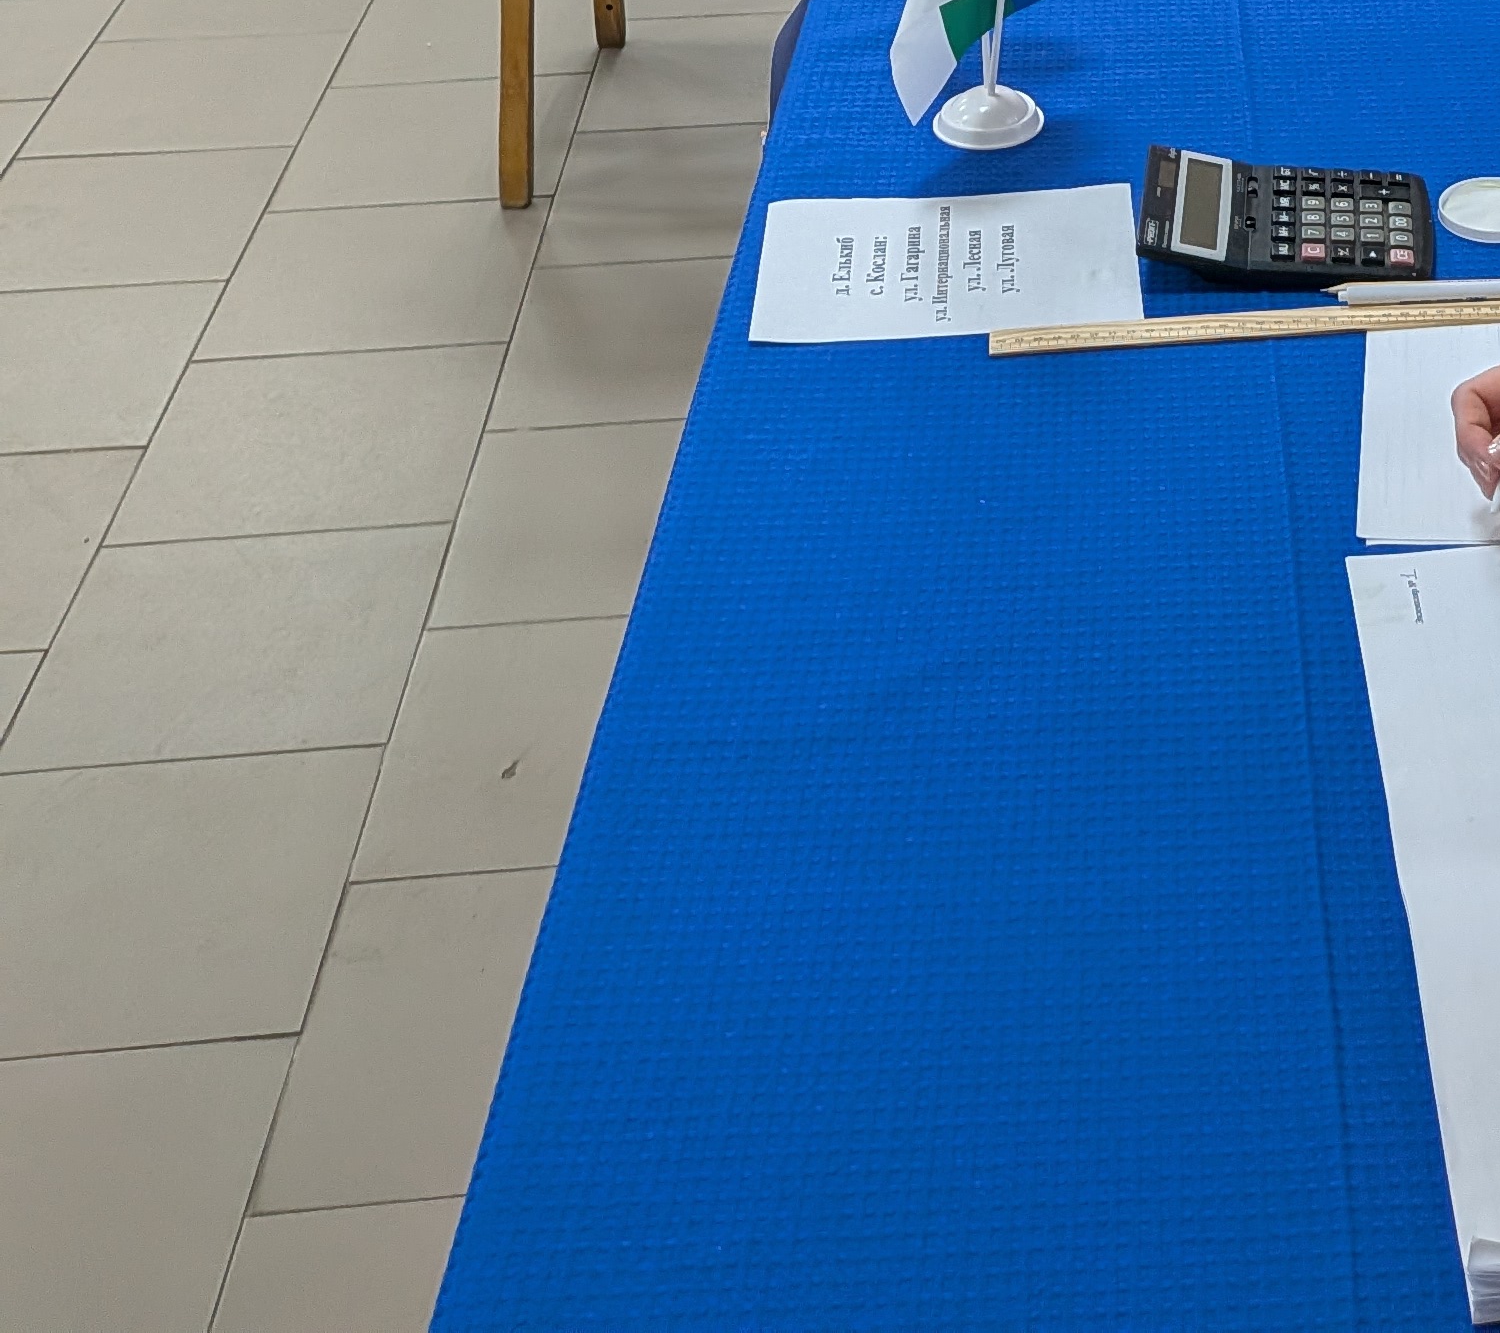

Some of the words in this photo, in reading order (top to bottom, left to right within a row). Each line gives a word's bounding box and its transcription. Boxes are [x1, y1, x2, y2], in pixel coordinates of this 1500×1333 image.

[1395, 216, 1408, 226] 00
[900, 226, 925, 281] Гагарина
[932, 206, 952, 304] Интернациональная
[963, 230, 982, 271] Лесная
[997, 225, 1019, 272] Луговая
[1307, 246, 1321, 254] C
[832, 236, 855, 282] Елькиб
[866, 236, 888, 283] Кослан:
[836, 285, 851, 296] д.
[869, 285, 885, 296] с.
[968, 273, 986, 292] ул.
[1000, 275, 1020, 293] ул.
[903, 284, 923, 302] ул.
[934, 306, 951, 322] ул.
